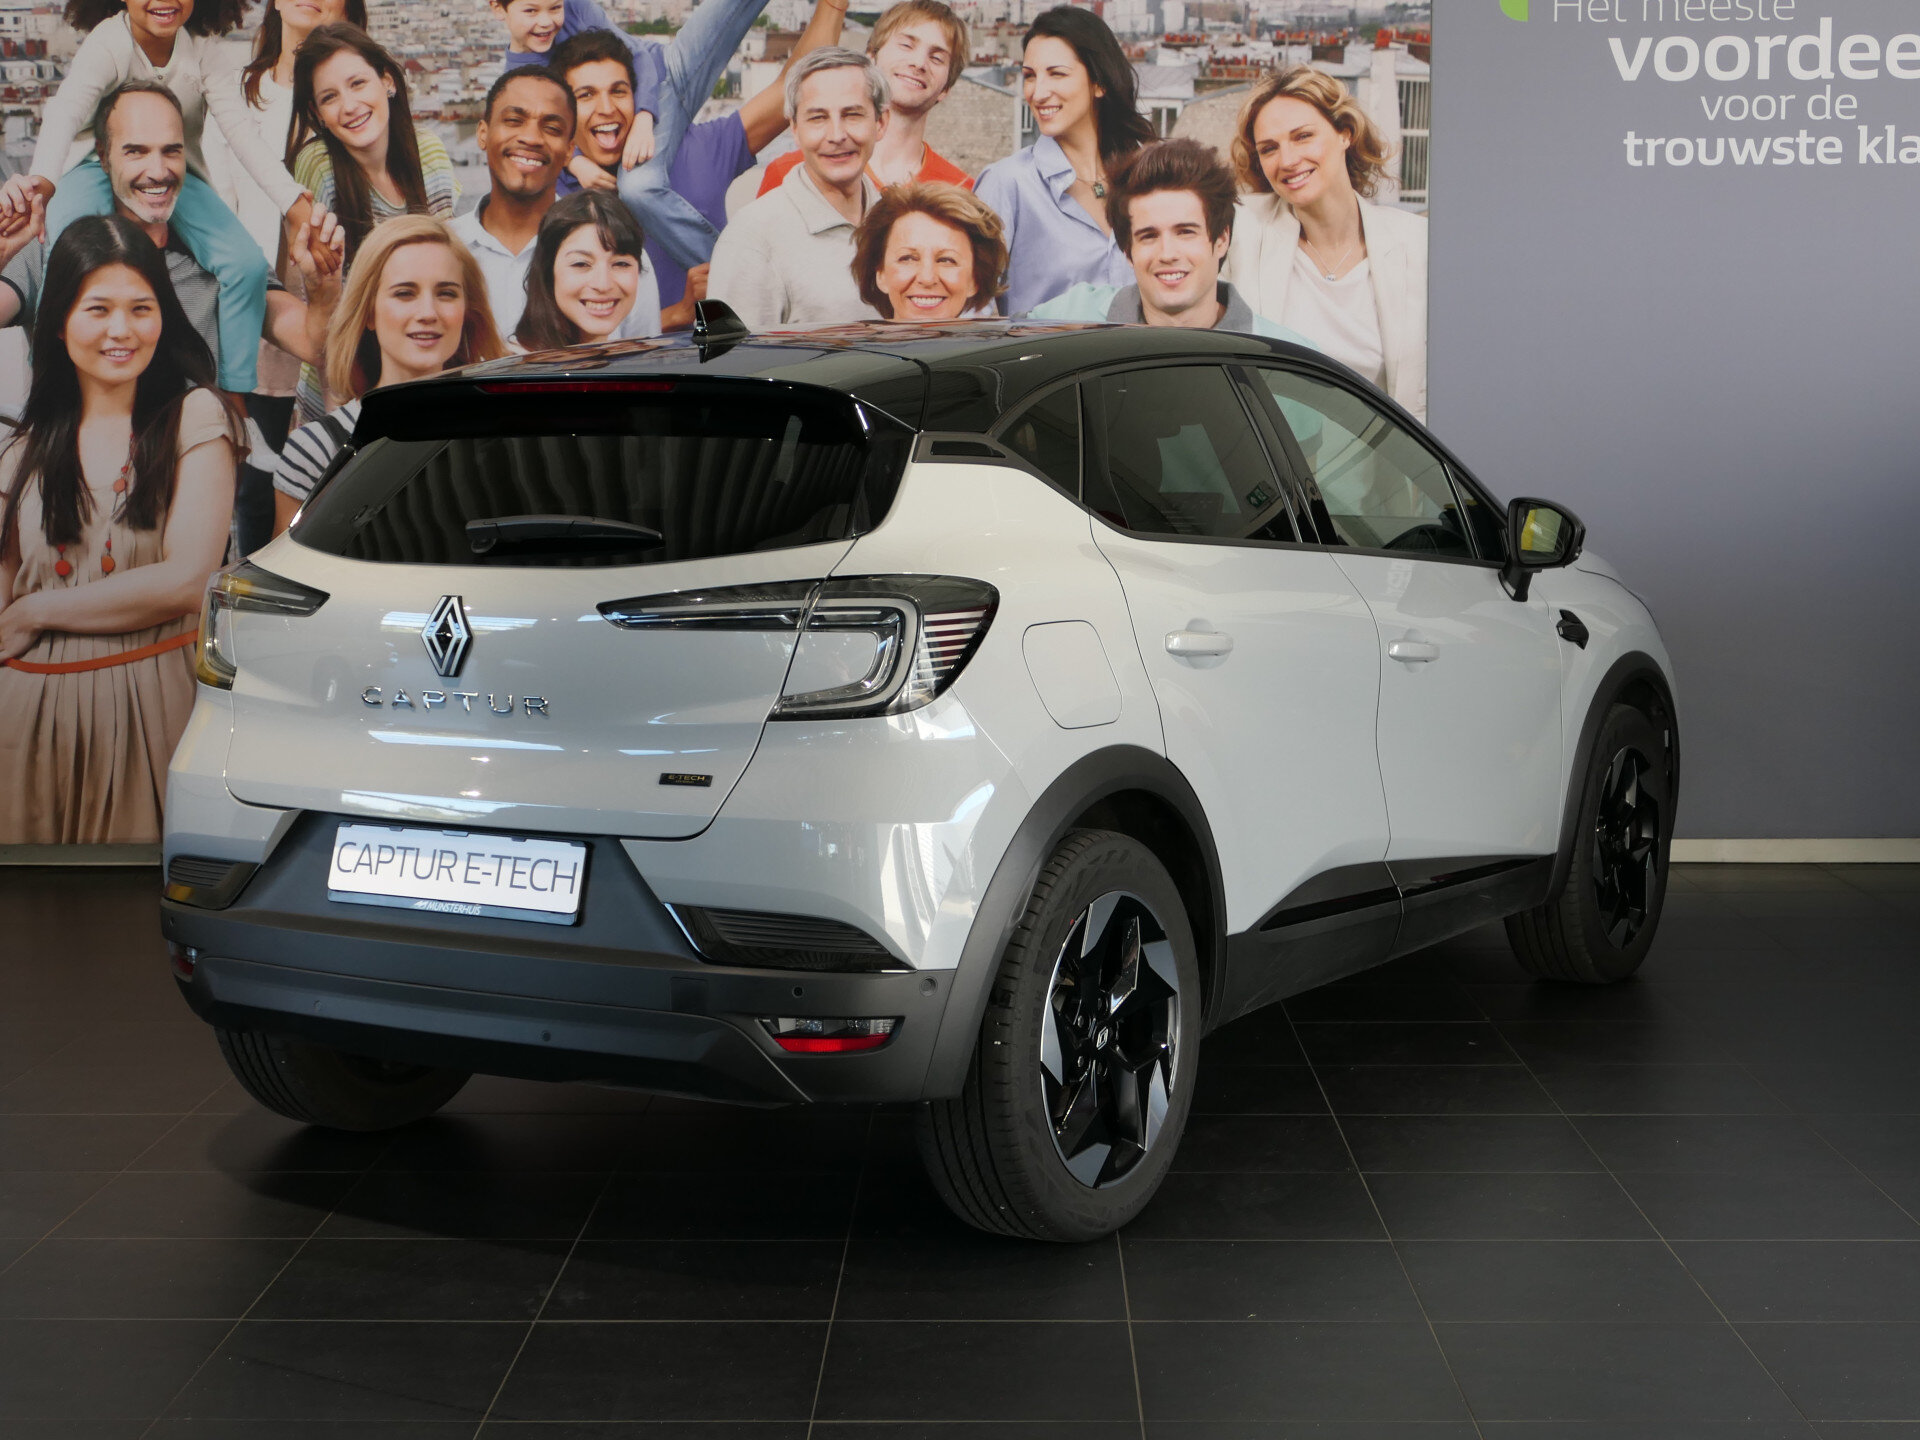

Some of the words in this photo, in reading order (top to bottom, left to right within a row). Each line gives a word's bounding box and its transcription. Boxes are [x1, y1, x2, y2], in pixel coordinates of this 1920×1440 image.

[1608, 16, 1920, 82] voordee
[1700, 94, 1796, 121] voor
[1807, 84, 1858, 120] de
[1623, 129, 1843, 167] trouwste
[1857, 125, 1920, 165] kla
[360, 686, 550, 716] CAPTUR
[336, 841, 458, 883] CAPTUR
[463, 852, 578, 895] E-TECH
